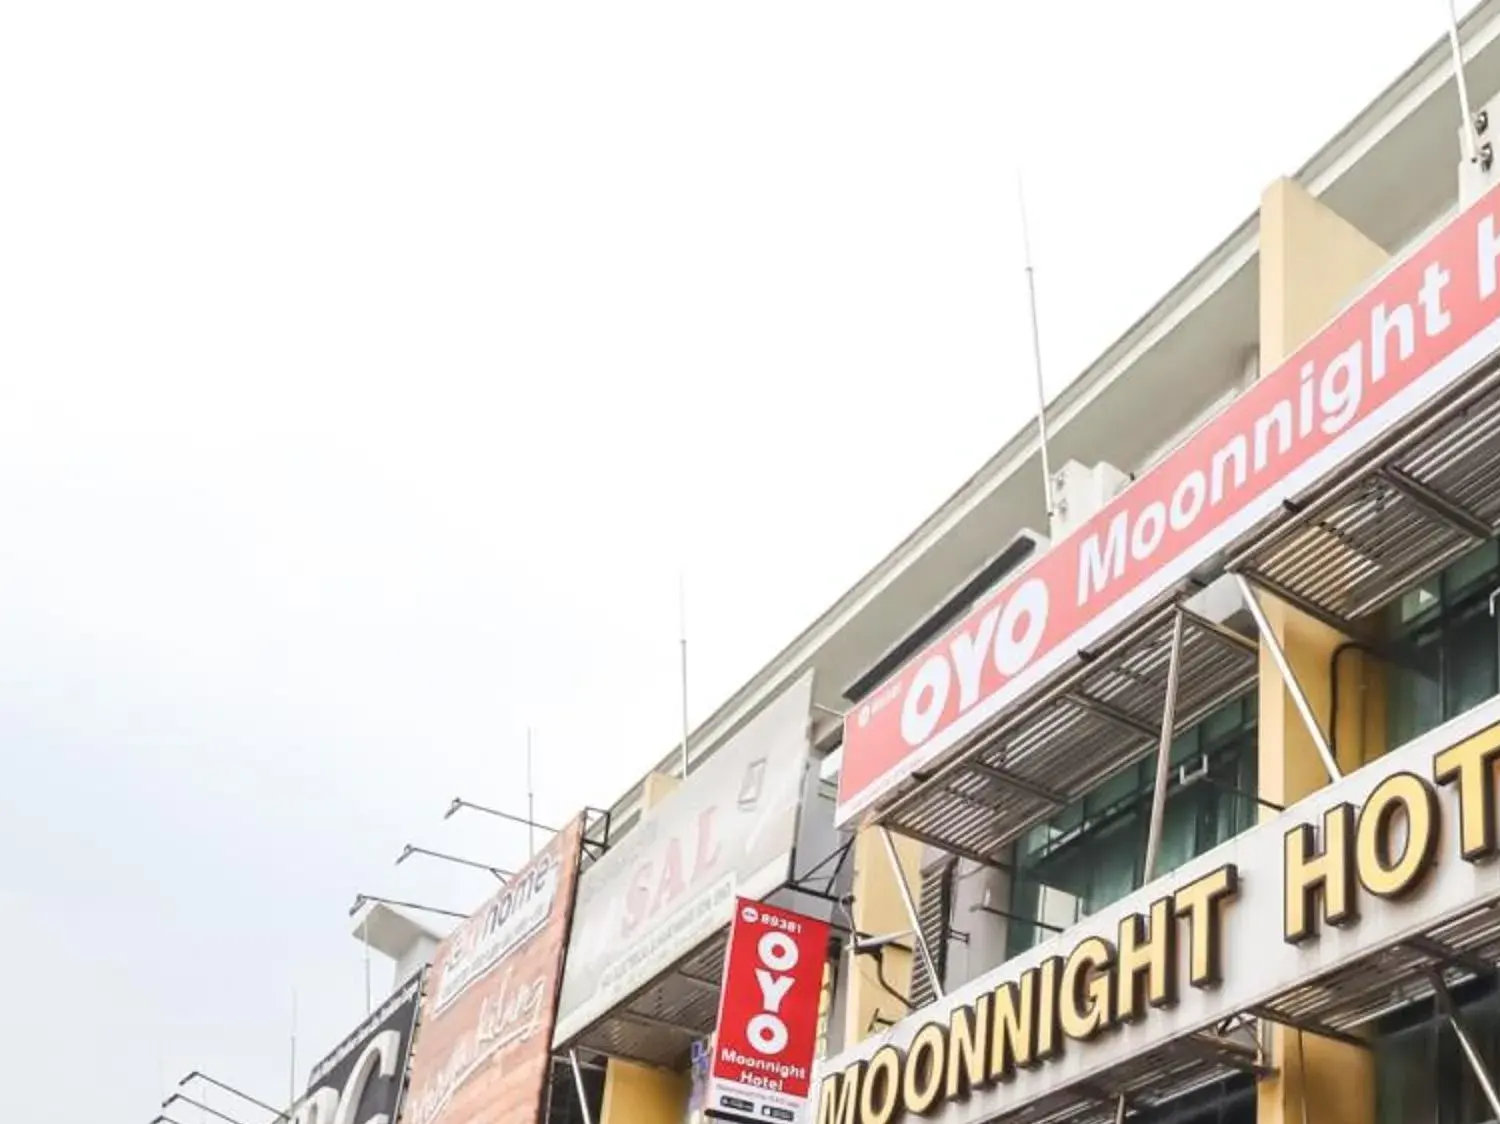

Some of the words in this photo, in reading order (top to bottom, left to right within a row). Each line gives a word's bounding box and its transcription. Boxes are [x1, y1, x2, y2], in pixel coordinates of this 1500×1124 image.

[901, 577, 1049, 745] OYO
[1076, 261, 1451, 606] Moonnight
[746, 931, 799, 1055] OYO
[721, 1048, 806, 1080] Moonnight
[740, 1071, 784, 1092] Hotel
